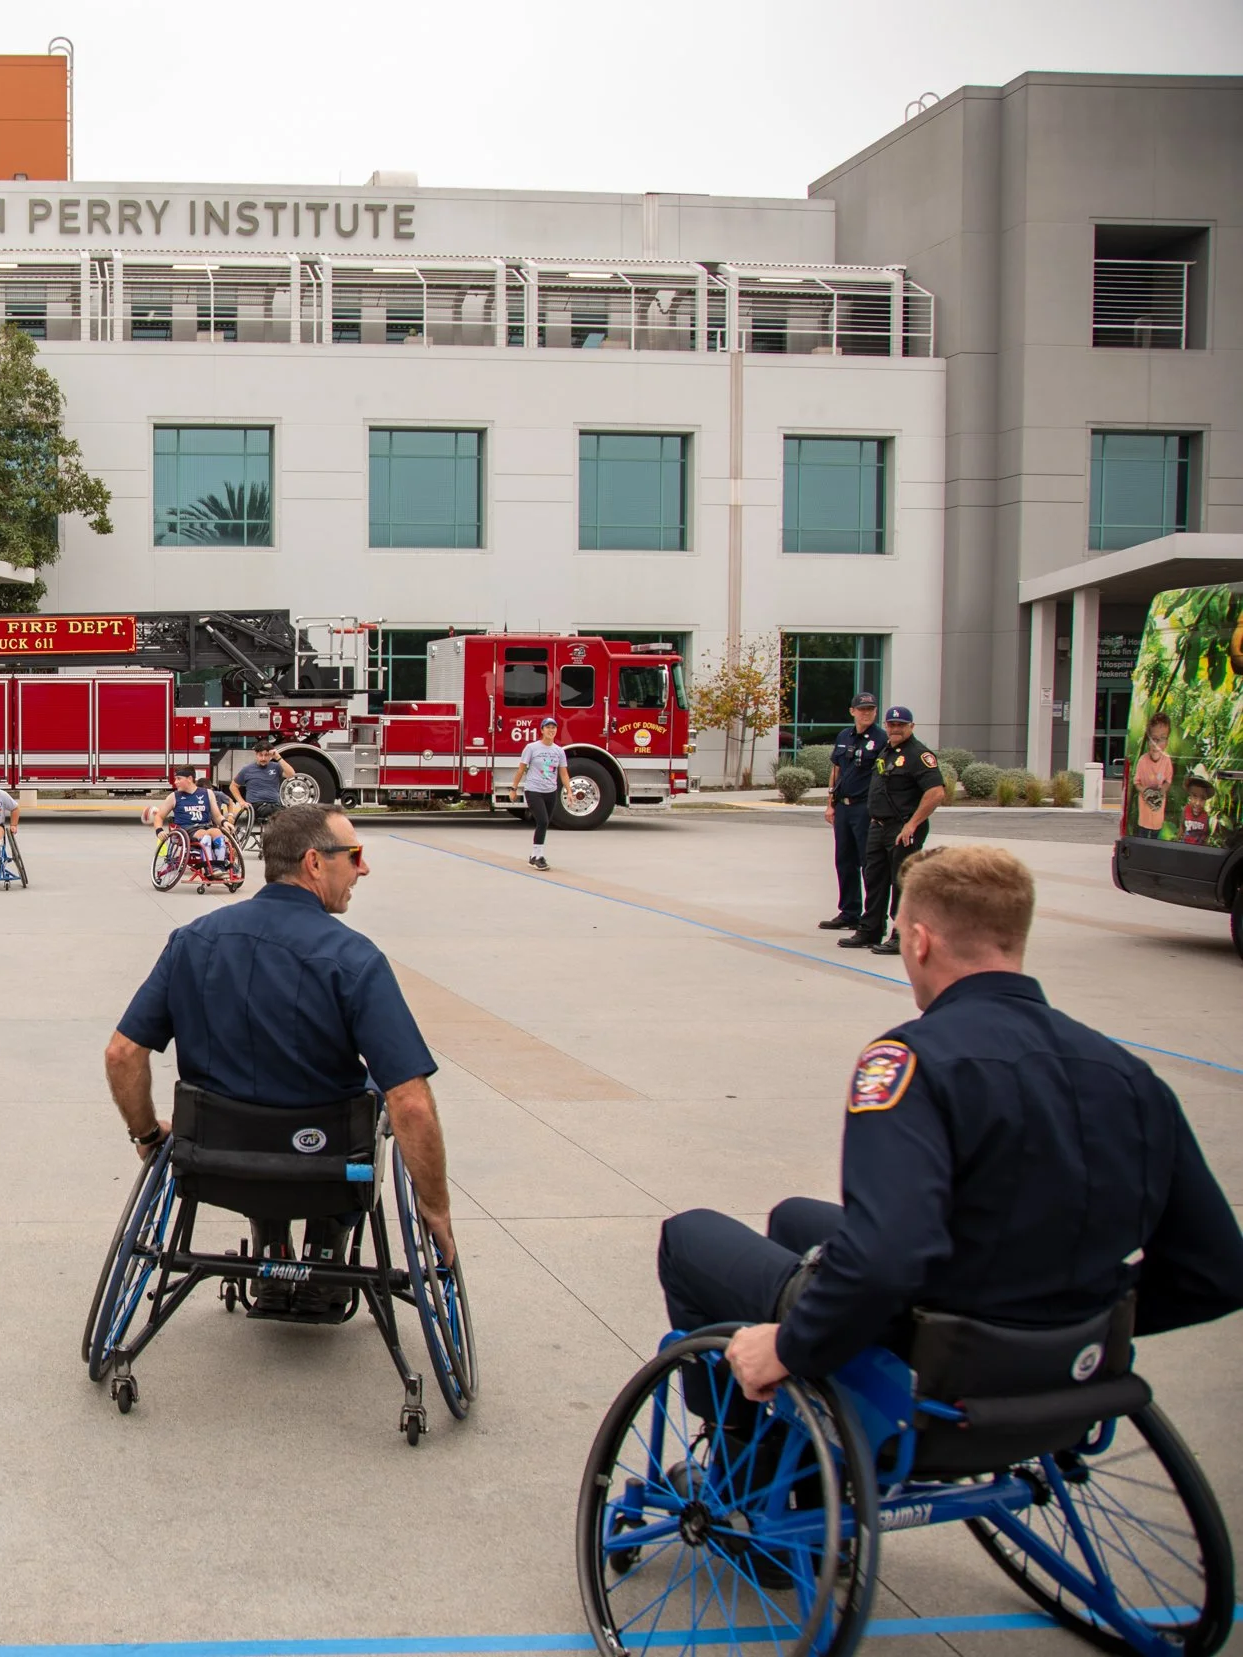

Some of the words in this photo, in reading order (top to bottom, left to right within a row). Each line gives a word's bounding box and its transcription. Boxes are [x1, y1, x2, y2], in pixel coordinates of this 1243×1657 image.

[28, 198, 170, 236] PERRY
[189, 200, 415, 240] INSTITUTE
[7, 621, 58, 634] FIRE
[68, 620, 126, 636] DEPT.
[34, 637, 54, 650] 611
[1103, 660, 1134, 669] Hospital
[1096, 670, 1128, 678] Weekend
[515, 719, 533, 727] DNY
[618, 723, 632, 735] CITY
[632, 721, 642, 729] OF
[642, 721, 668, 735] DOWNEY
[511, 727, 538, 742] 611
[634, 746, 652, 754] FIRE
[189, 811, 203, 821] 20
